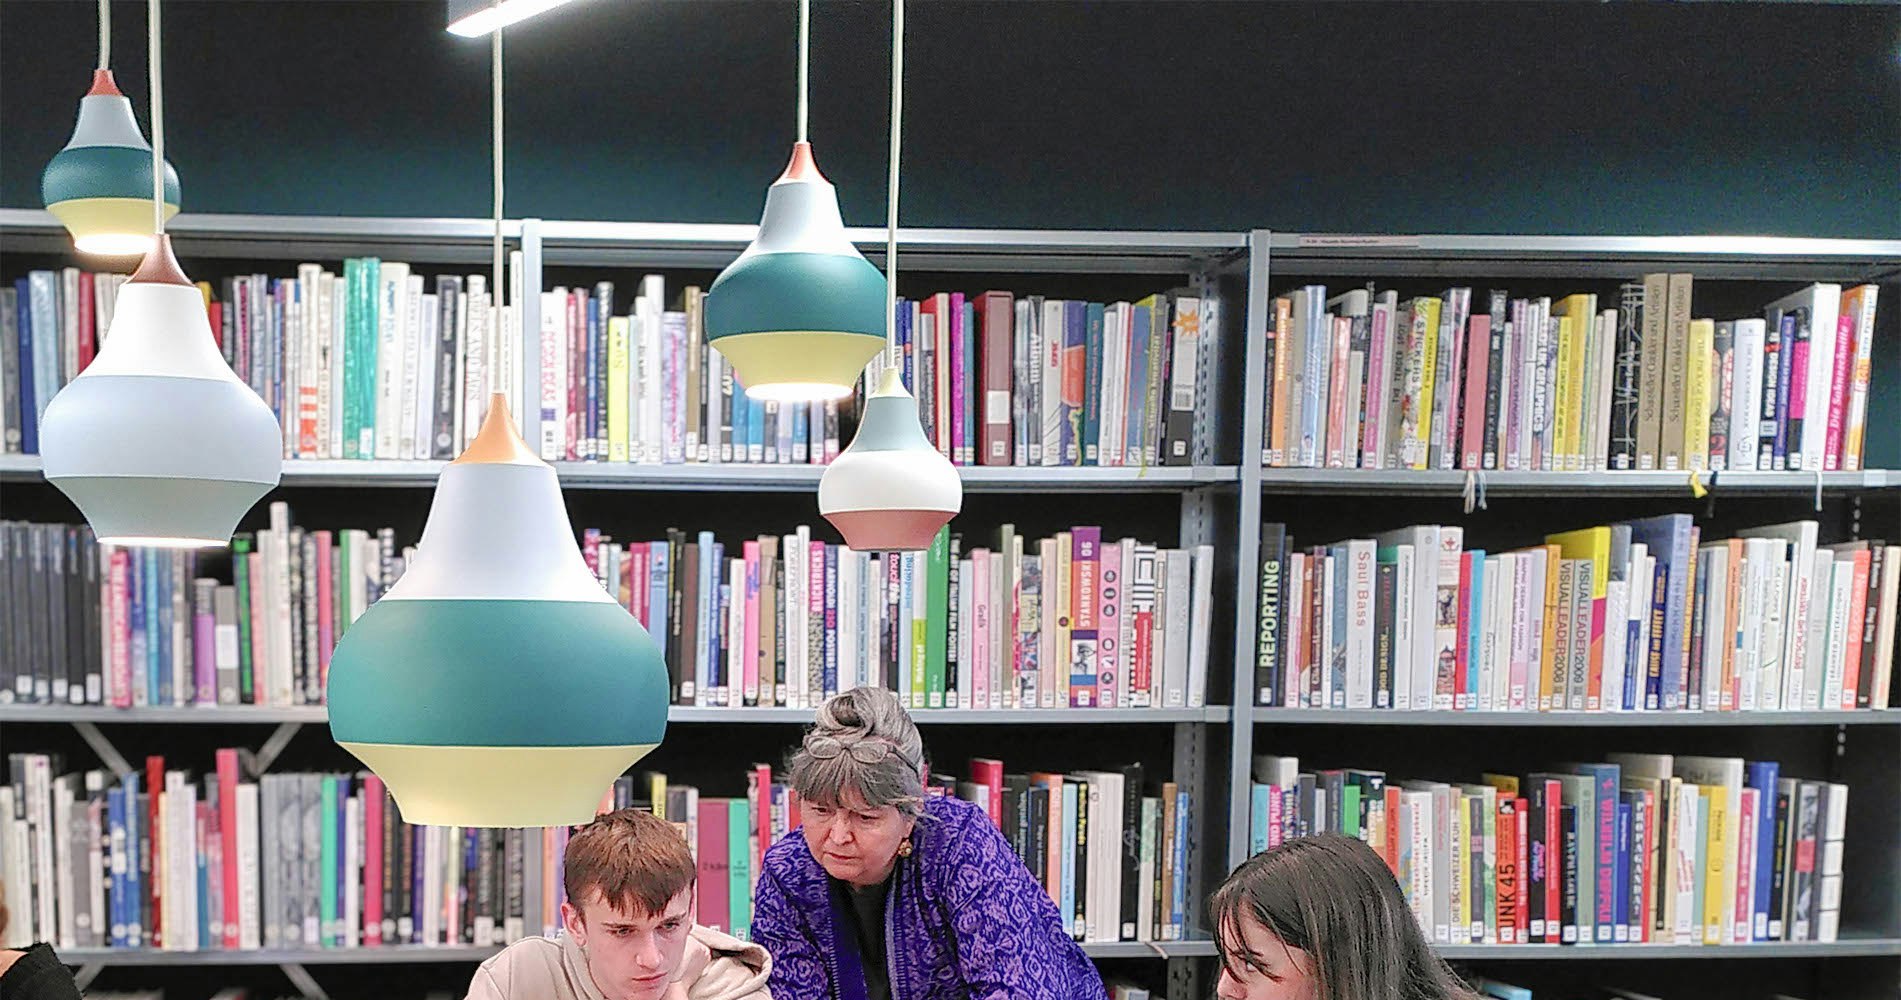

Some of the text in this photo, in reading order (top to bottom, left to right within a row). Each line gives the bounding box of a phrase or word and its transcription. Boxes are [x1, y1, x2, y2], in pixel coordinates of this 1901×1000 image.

[1030, 333, 1042, 384] Album
[1534, 366, 1546, 432] GRAPHICS
[903, 556, 912, 610] introducing
[1080, 560, 1092, 627] STANKOWSKI
[1356, 551, 1371, 627] Saul Bass
[1259, 560, 1280, 667] REPORTING
[1651, 608, 1664, 639] EFFECT
[825, 630, 836, 669] POSTERS
[1649, 651, 1659, 677] CAUSE
[1270, 791, 1280, 823] PUNK
[1452, 821, 1460, 923] DIE SCHWEIZER KUH
[1498, 864, 1515, 931] UNK 45
